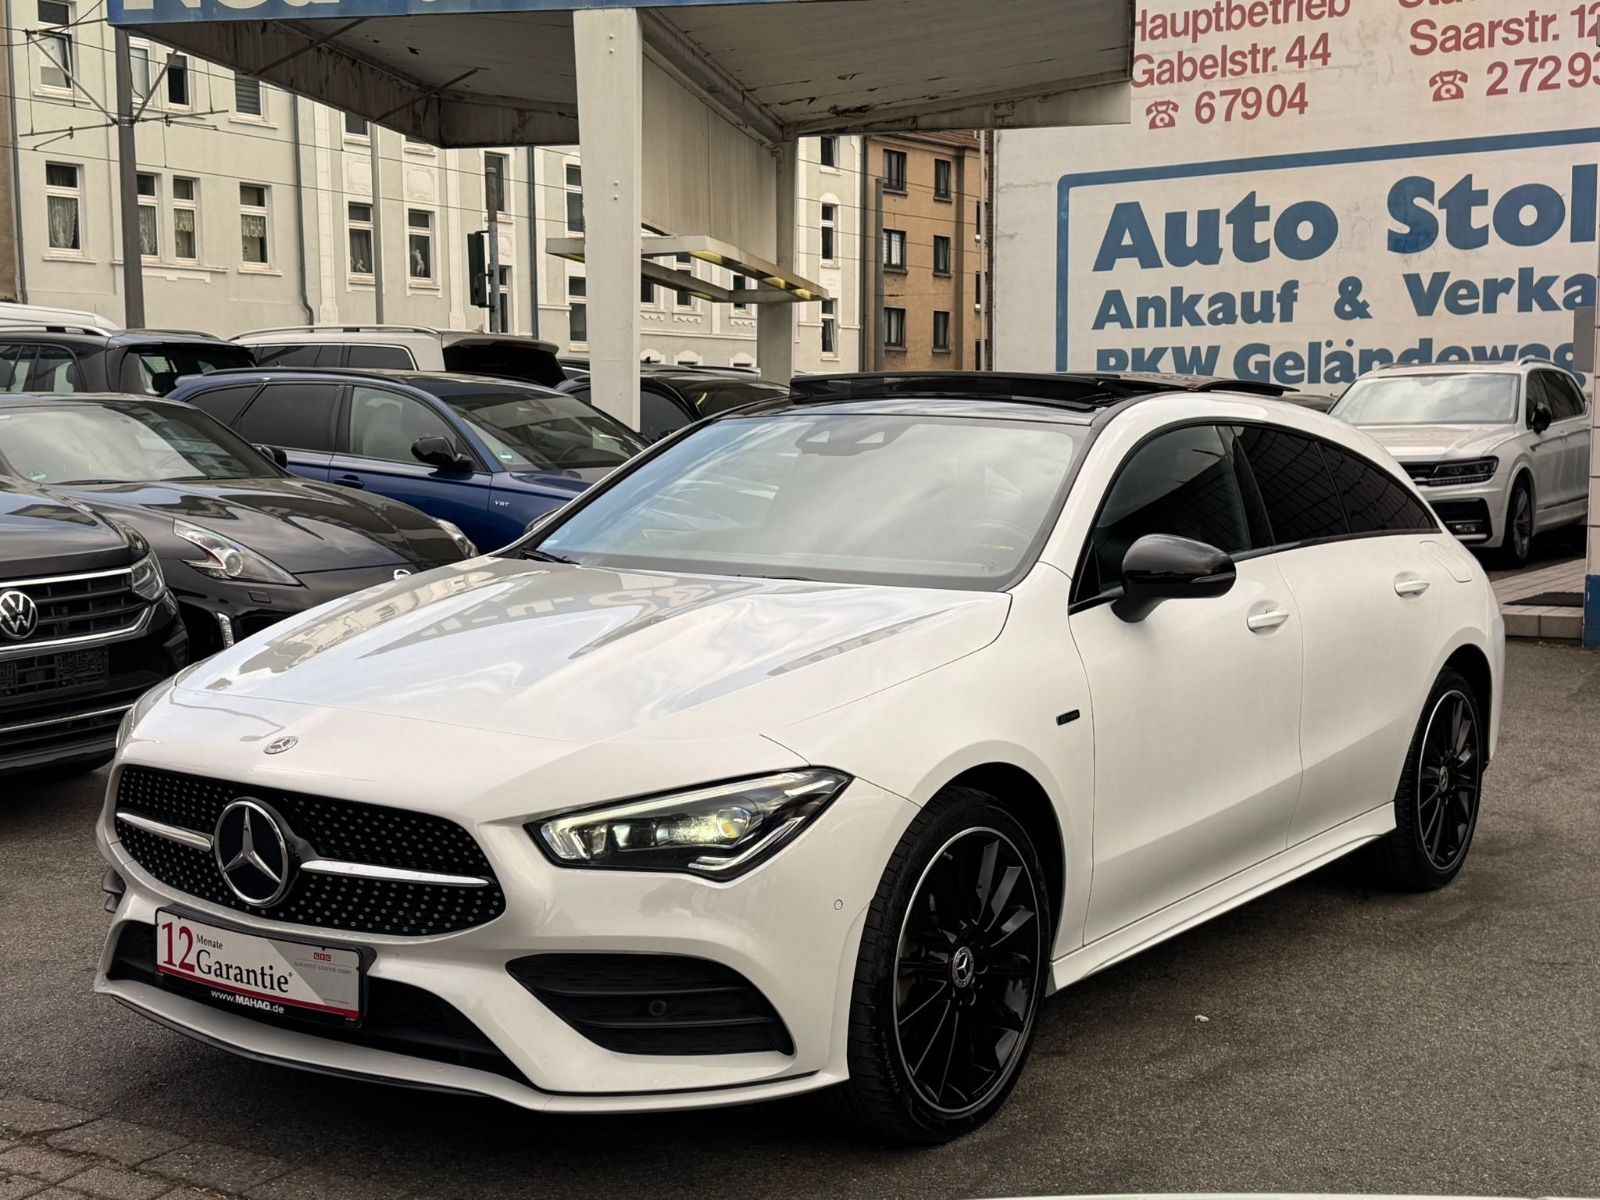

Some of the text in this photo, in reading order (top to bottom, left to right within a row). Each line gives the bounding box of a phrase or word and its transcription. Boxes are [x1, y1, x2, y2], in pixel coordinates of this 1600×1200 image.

[1409, 10, 1560, 56] Saarstr.
[1131, 33, 1332, 88] Gabelstr. 44
[1092, 163, 1598, 272] Auto Stol
[1091, 267, 1597, 330] Ankauf & Verka
[1096, 345, 1221, 377] PKW
[162, 922, 196, 973] 12
[196, 933, 223, 950] Monate
[211, 990, 285, 1014] www.MAHAG.de
